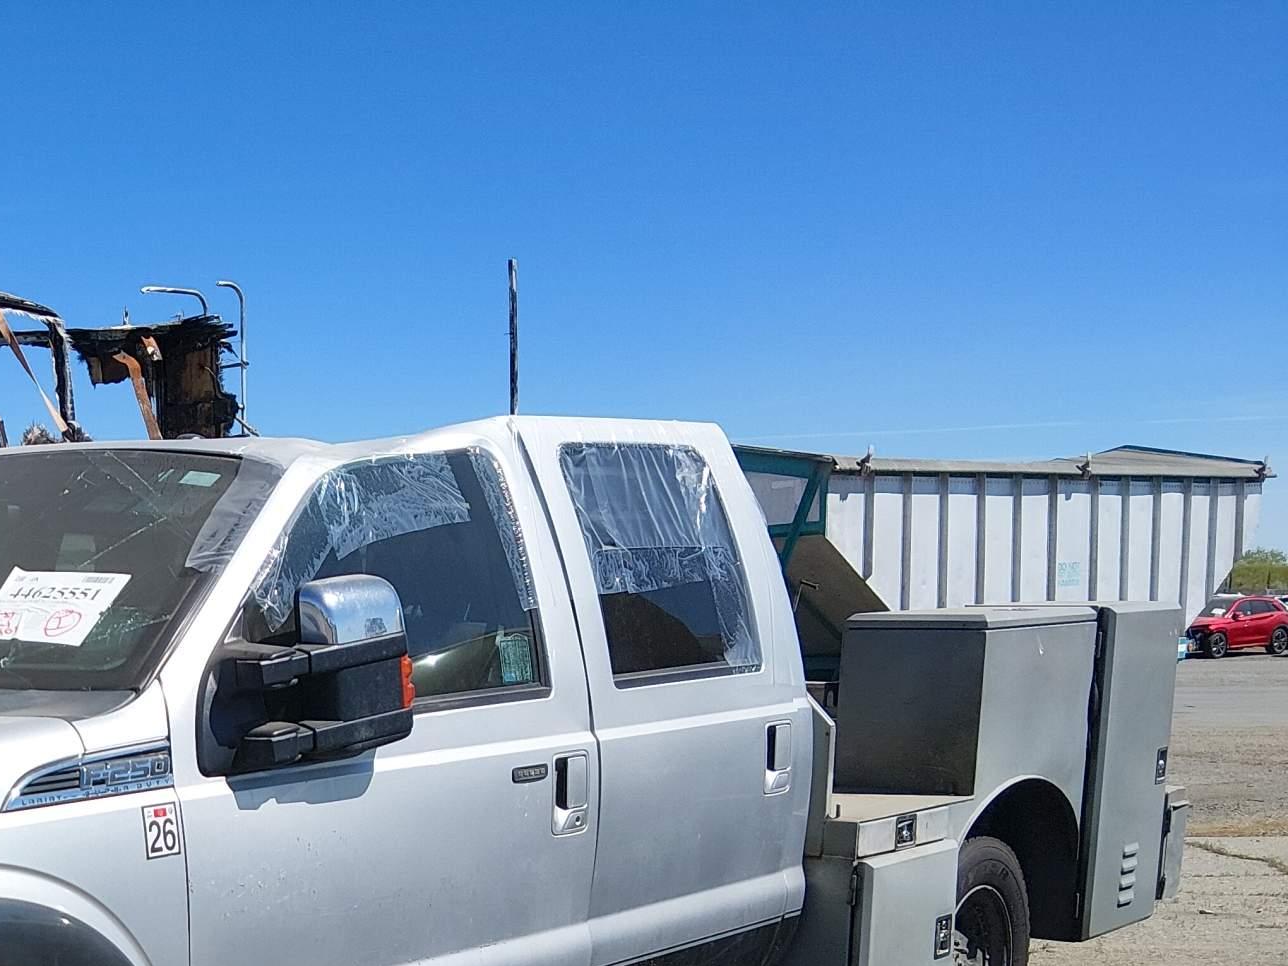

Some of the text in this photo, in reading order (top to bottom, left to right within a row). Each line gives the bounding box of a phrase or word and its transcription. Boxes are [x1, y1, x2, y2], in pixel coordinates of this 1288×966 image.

[10, 586, 102, 601] 44625551
[136, 778, 171, 790] DUTY
[148, 817, 177, 854] 26
